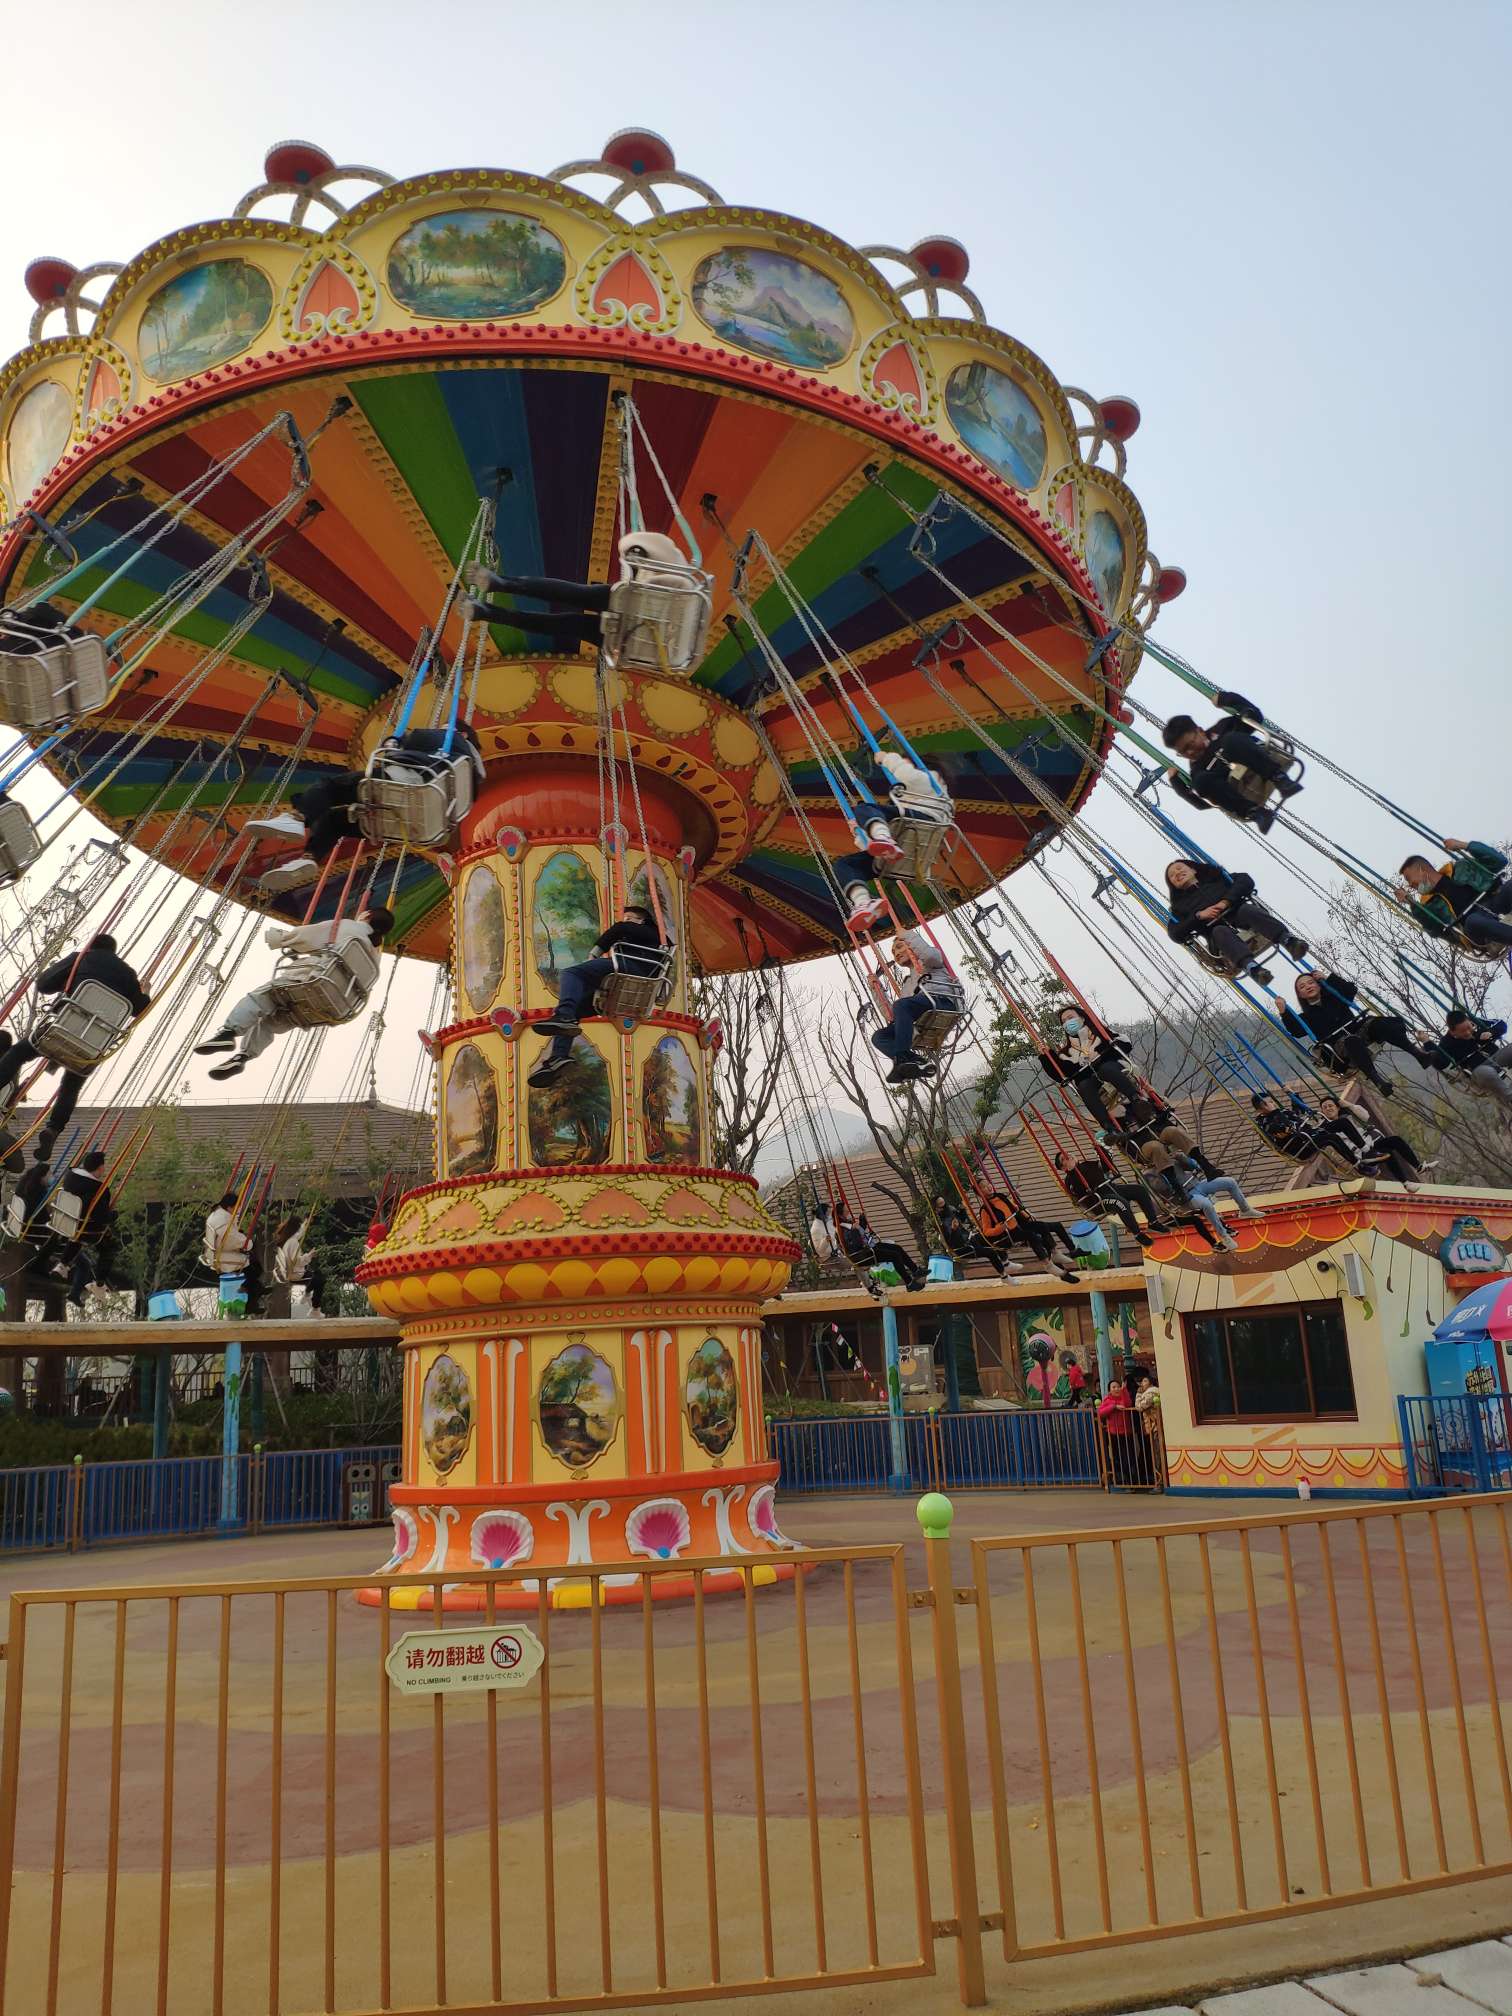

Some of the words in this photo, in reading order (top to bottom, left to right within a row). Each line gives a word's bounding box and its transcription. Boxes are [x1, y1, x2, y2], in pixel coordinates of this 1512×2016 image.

[406, 1644, 485, 1669] 请勿翻越
[406, 1679, 417, 1687] NO
[418, 1677, 452, 1686] CLIMBING
